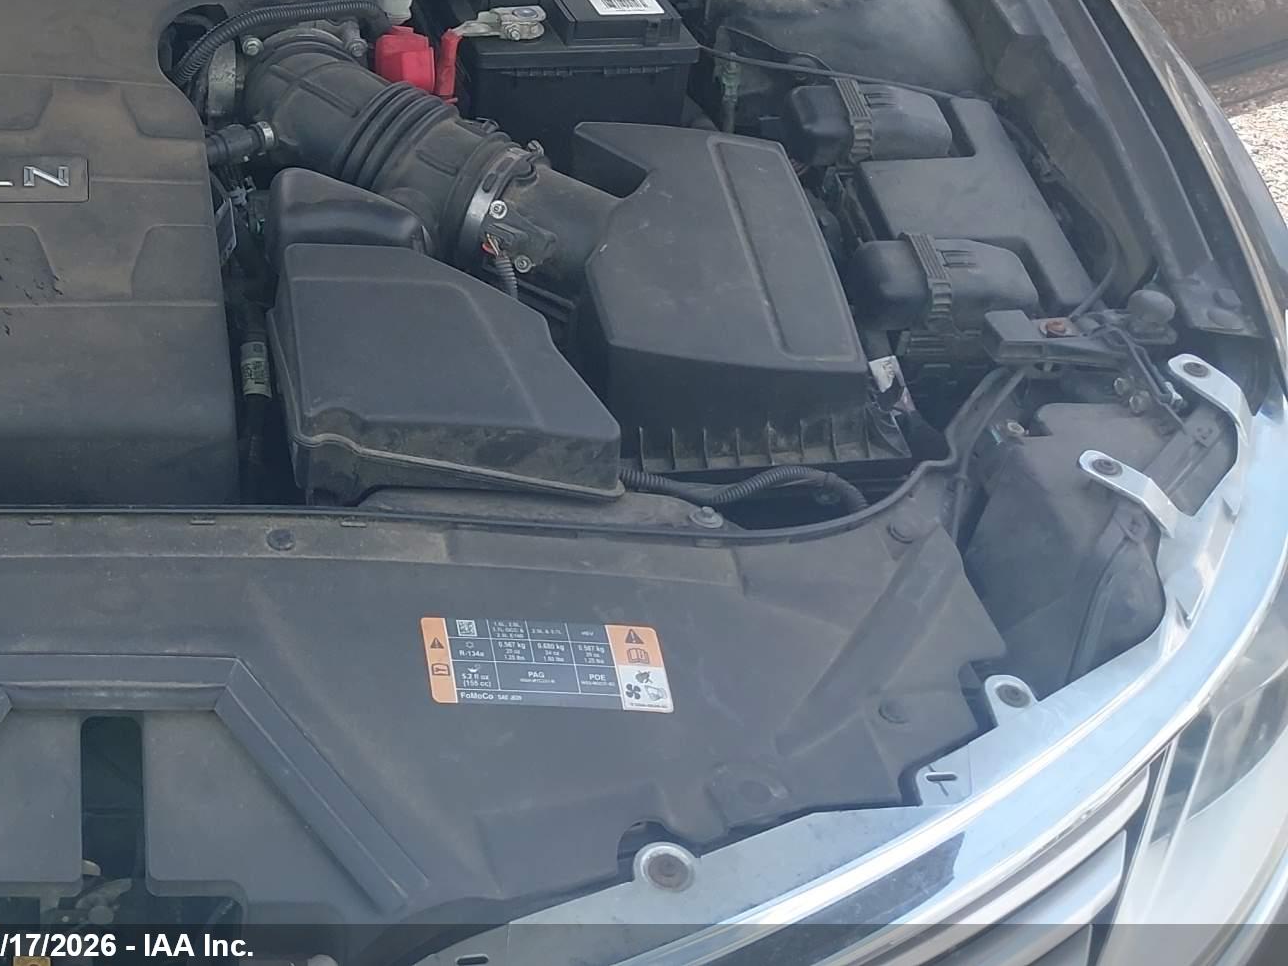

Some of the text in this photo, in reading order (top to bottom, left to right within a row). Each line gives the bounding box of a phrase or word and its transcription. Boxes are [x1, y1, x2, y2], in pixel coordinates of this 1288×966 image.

[517, 641, 526, 650] kg
[459, 649, 485, 657] R-134a
[527, 671, 545, 679] PAG
[589, 673, 606, 681] POE
[460, 691, 494, 700] FoMoCo
